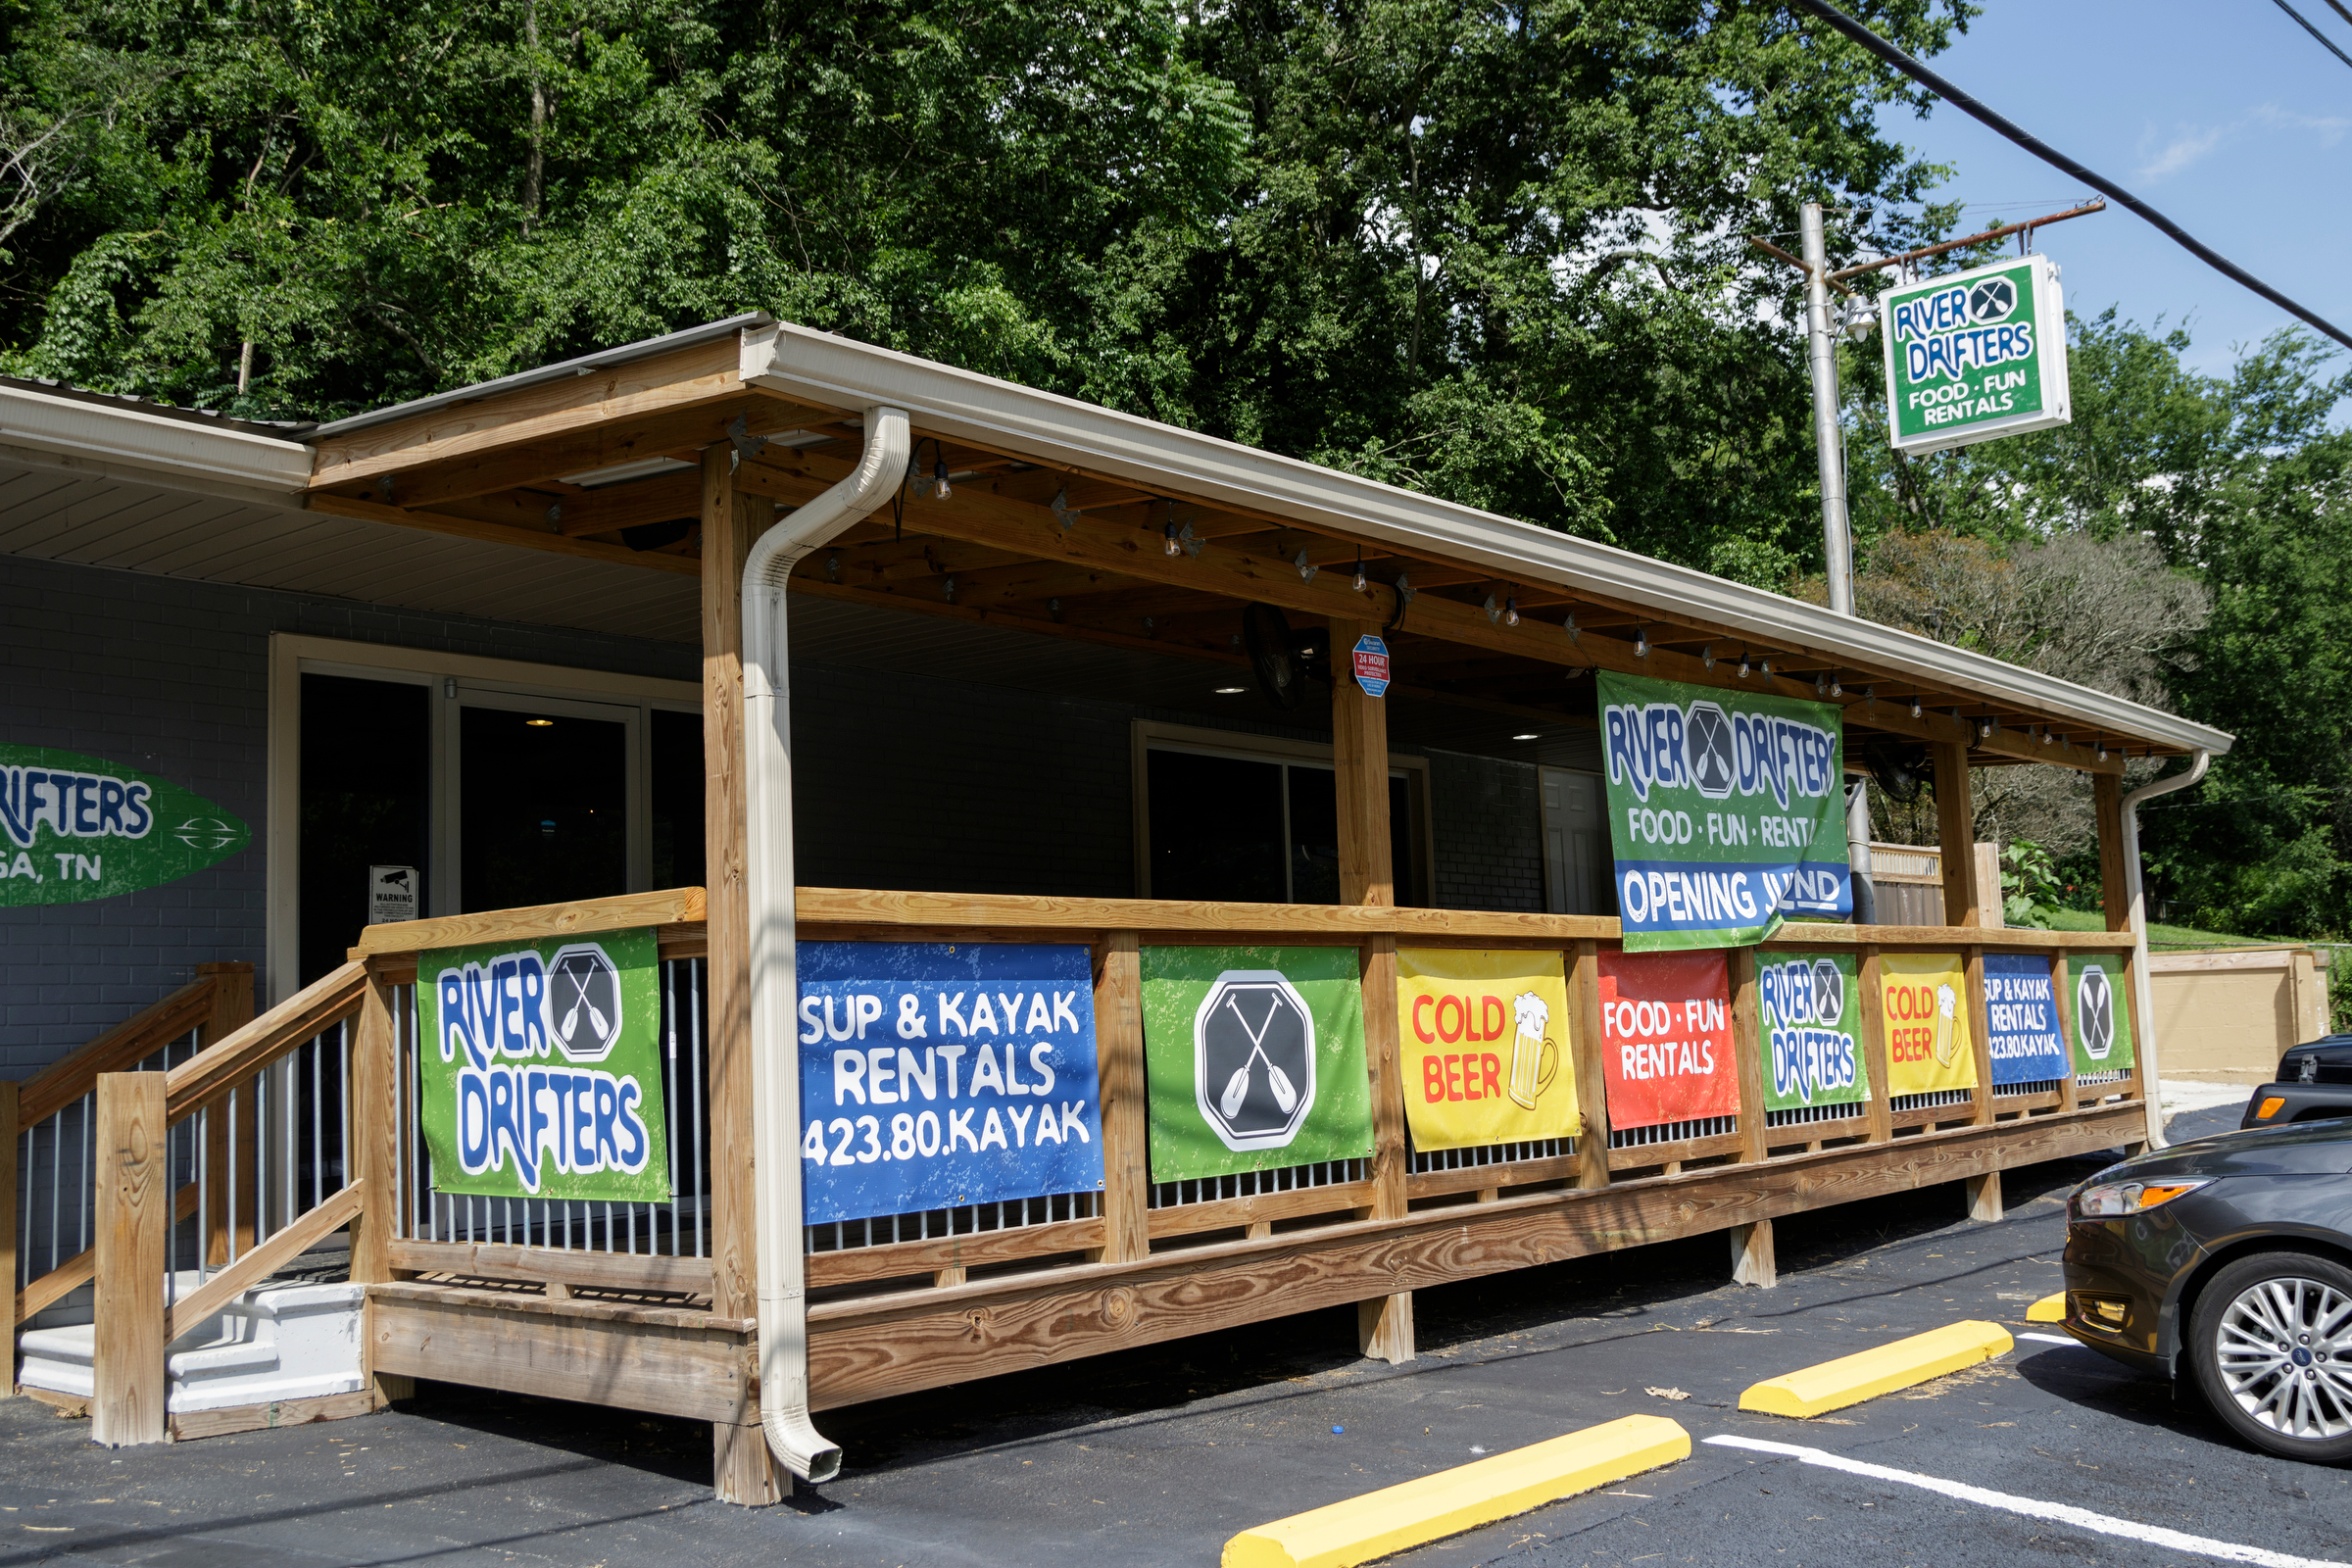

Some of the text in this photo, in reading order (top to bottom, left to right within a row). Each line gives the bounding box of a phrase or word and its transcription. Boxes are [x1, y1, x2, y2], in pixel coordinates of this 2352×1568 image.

[1895, 287, 1968, 341] RIVER
[1908, 323, 2032, 382] DRIFTERS
[1909, 368, 2026, 410] FOOD FUN
[1924, 392, 2014, 426] RENTALS
[1359, 654, 1385, 667] 24 HOUR
[1606, 706, 1689, 800] RIVER
[1628, 808, 1692, 845] FOOD
[1707, 812, 1748, 847] FUN
[54, 853, 101, 881] TN
[376, 893, 413, 903] WARNING
[1623, 869, 1757, 923] OPENING
[440, 953, 549, 1069] RIVER
[1761, 960, 1815, 1030] RIVER
[1886, 986, 1934, 1022] COLD
[1984, 978, 2050, 1003] SUP & KAYAK
[799, 990, 1079, 1045] SUP & KAYAK
[1412, 994, 1505, 1045] COLD
[1603, 998, 1725, 1039] FOOD FUN
[1990, 1004, 2046, 1032] RENTALS
[1621, 1039, 1714, 1080] RENTALS
[1772, 1029, 1854, 1102] DRIFTERS
[1891, 1027, 1932, 1063] BEER
[833, 1042, 1055, 1107] RENTALS
[1422, 1053, 1501, 1103] BEER
[459, 1069, 648, 1192] DRIFTERS
[800, 1099, 1090, 1167] 423.80.KAYAK
